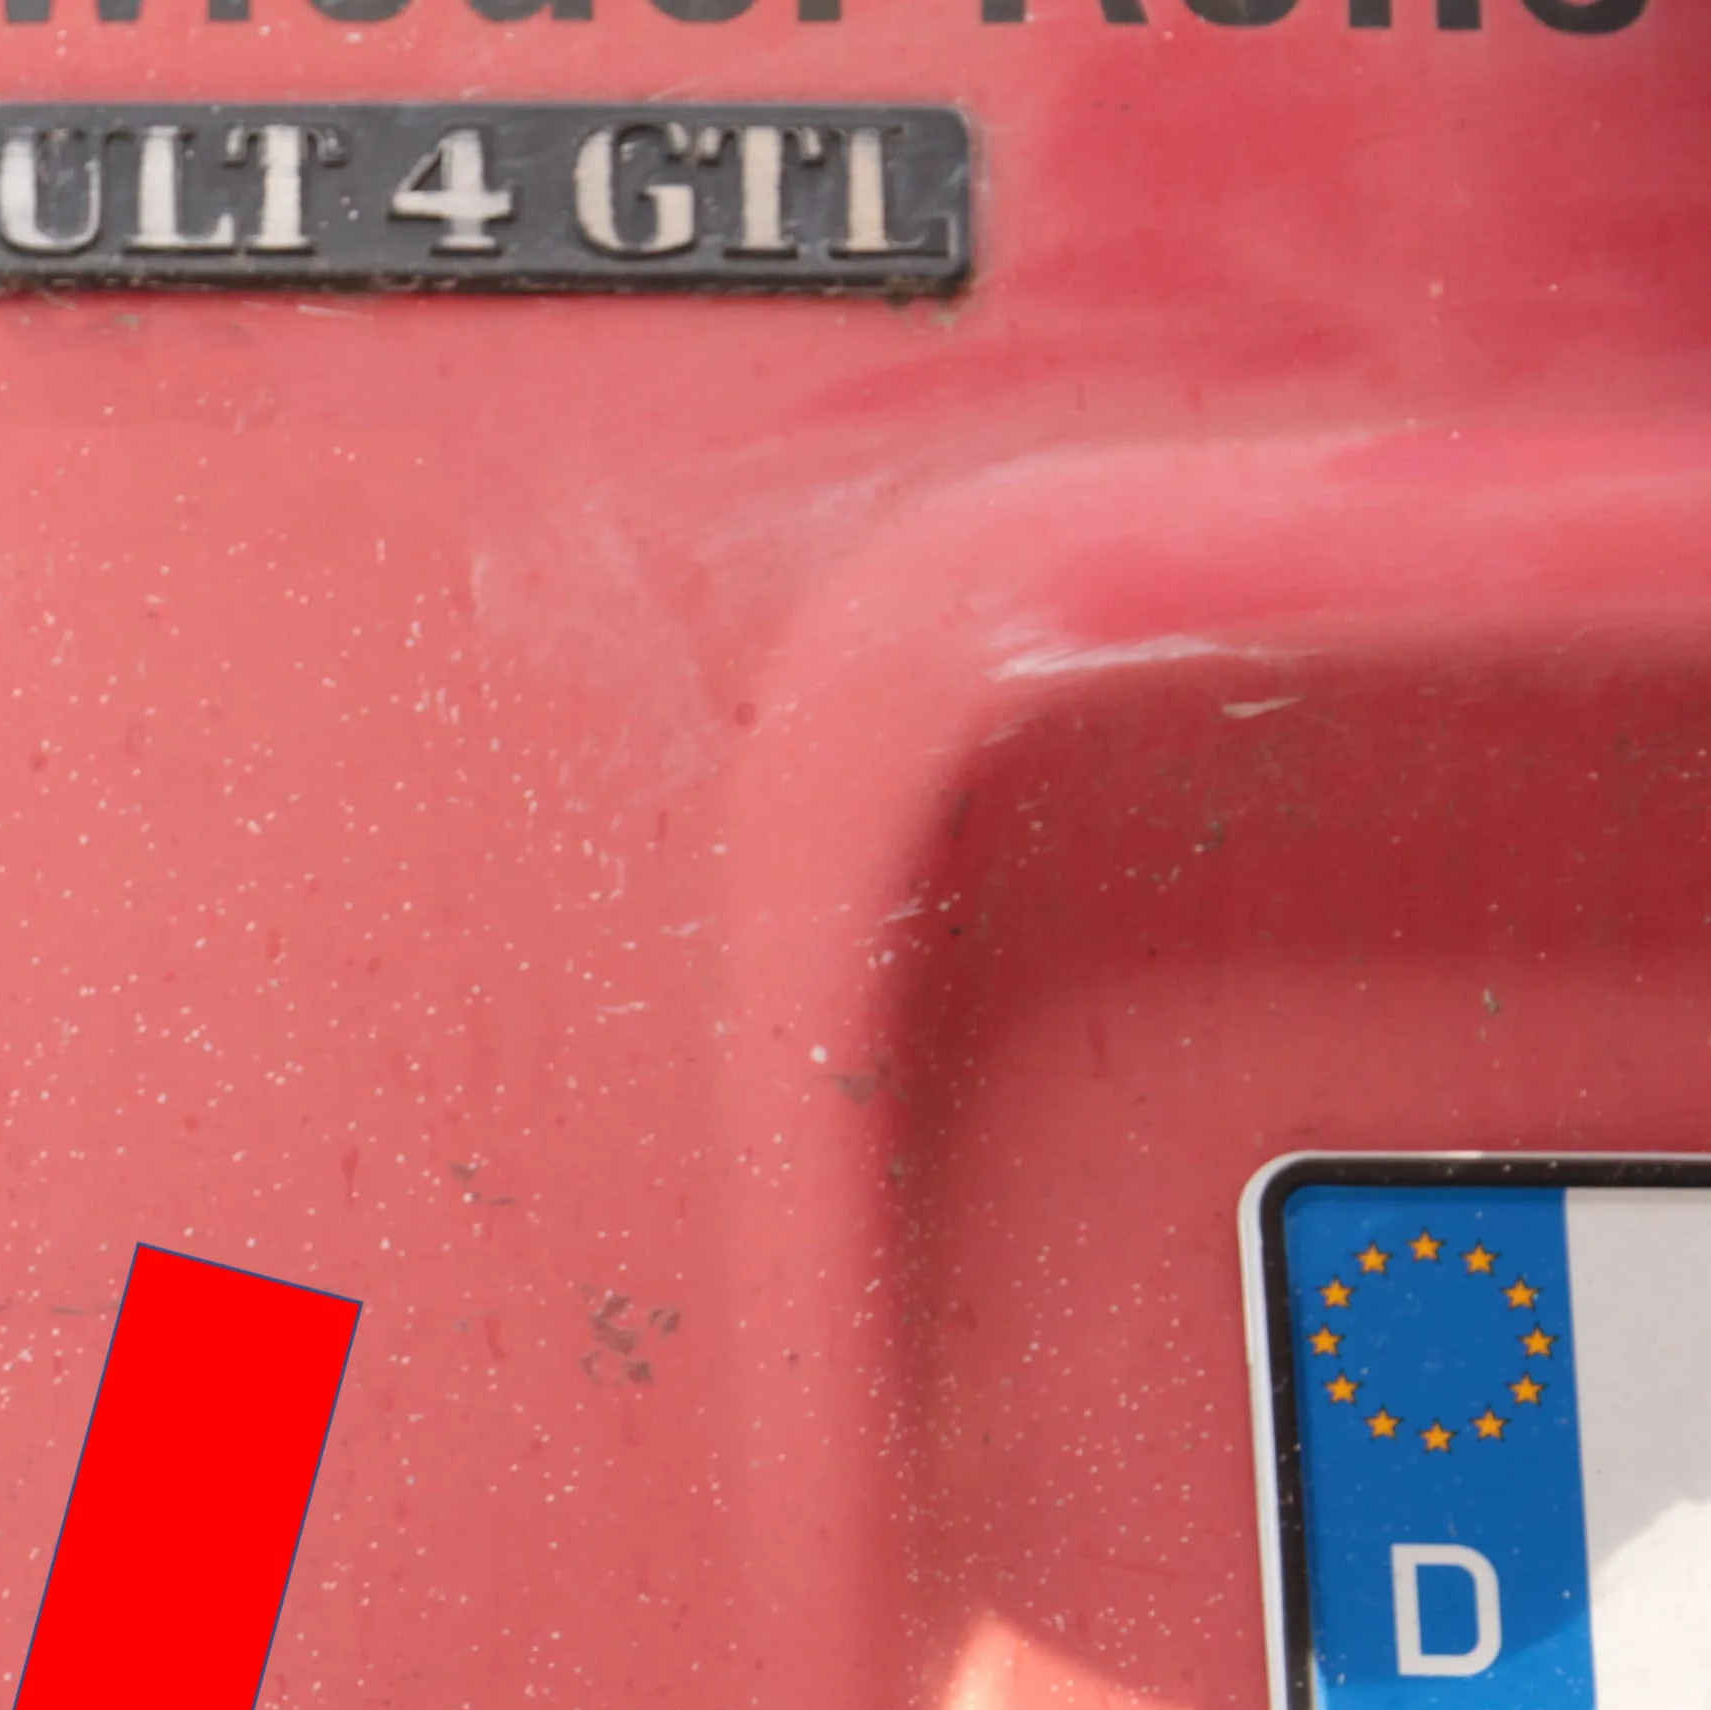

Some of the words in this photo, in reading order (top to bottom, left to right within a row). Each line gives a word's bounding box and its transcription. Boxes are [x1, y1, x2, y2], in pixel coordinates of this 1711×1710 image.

[386, 125, 520, 258] 4
[573, 120, 952, 262] GTL
[1391, 1543, 1503, 1678] D
